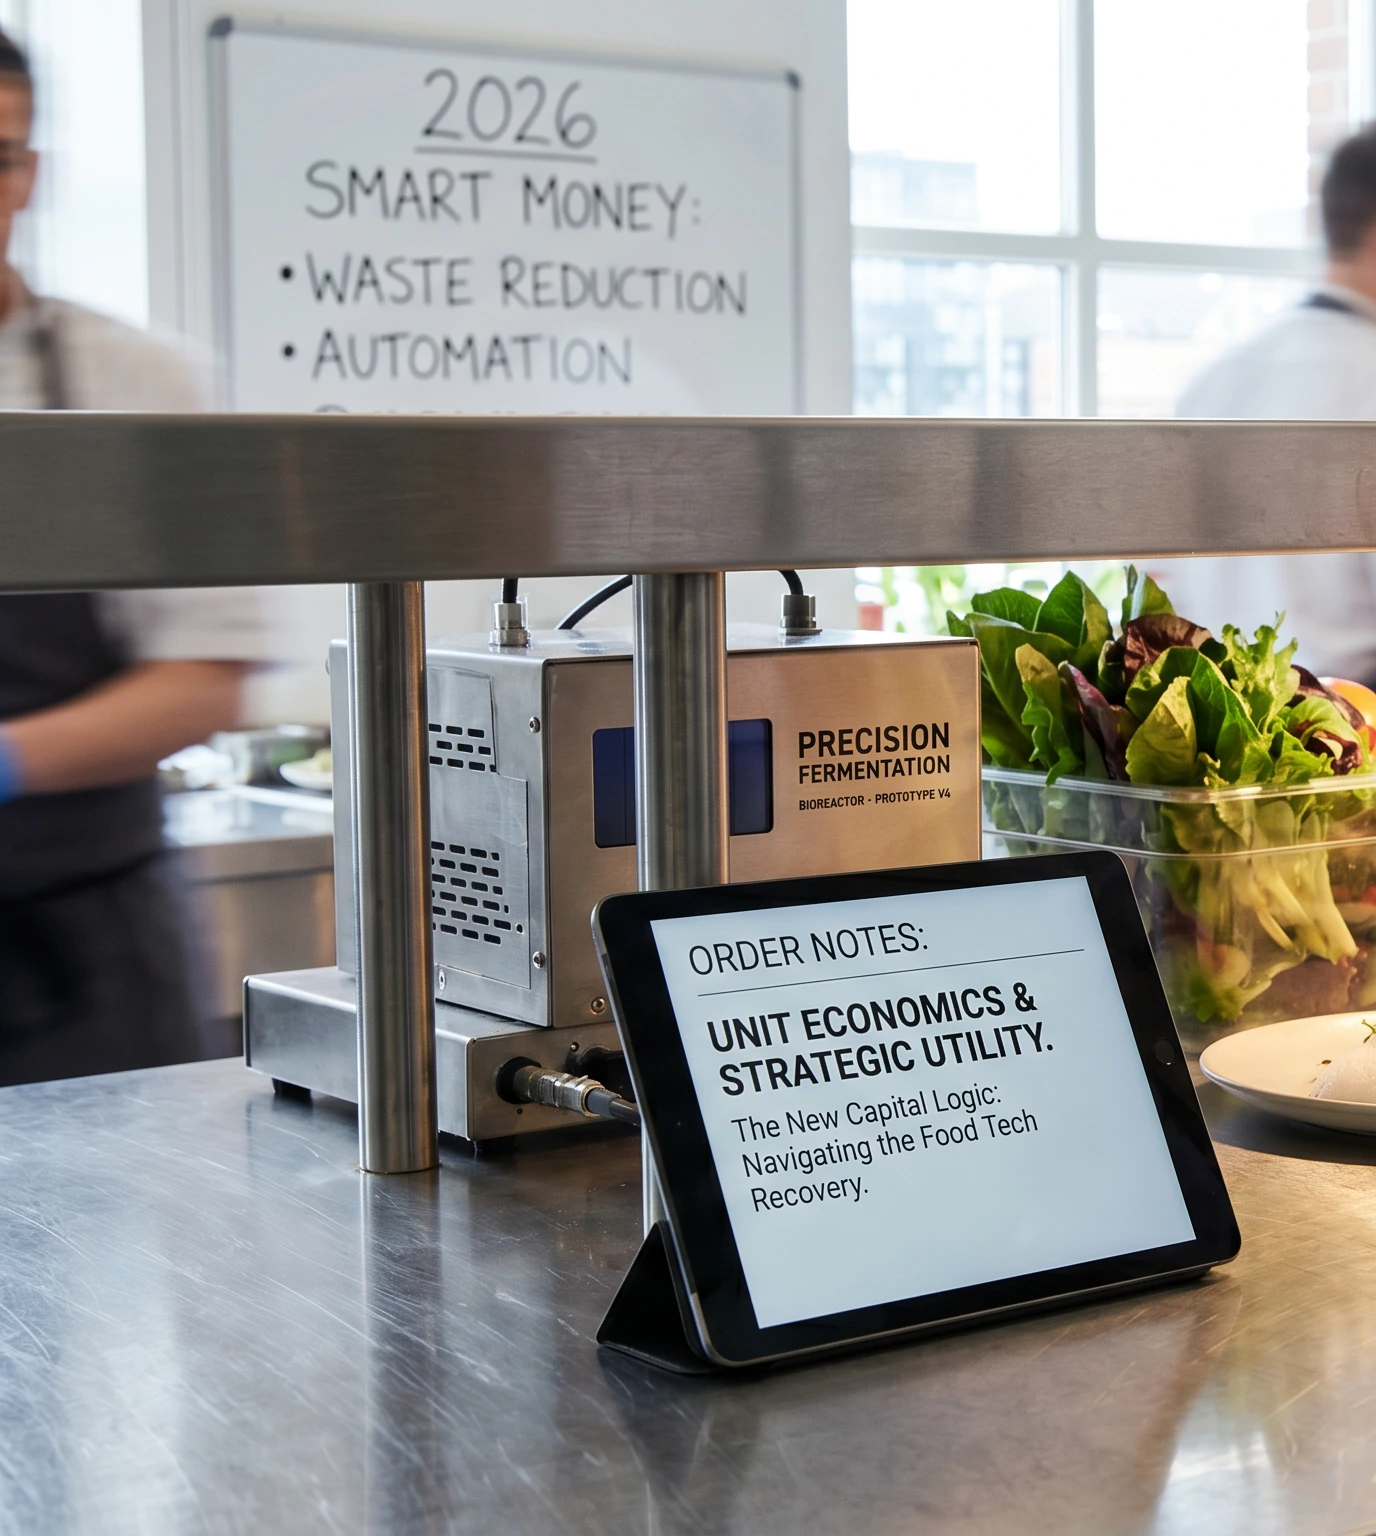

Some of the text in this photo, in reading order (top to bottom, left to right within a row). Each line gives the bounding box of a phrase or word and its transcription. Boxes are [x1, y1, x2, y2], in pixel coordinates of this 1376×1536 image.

[422, 69, 597, 148] 2026
[305, 161, 701, 239] SMART MONEY:
[306, 252, 747, 316] WASTE REDUCTION
[311, 329, 632, 385] AUTOMATION
[799, 722, 949, 758] PRECISION
[799, 755, 949, 784] FERMENTATION
[799, 794, 865, 811] BIOREACTOR
[875, 790, 935, 804] PROTOTYPE
[937, 787, 951, 799] V4
[690, 923, 927, 975] ORDER NOTES:
[707, 981, 1038, 1052] UNIT ECONOMICS &
[720, 1022, 1053, 1095] STRATEGIC UTILITY.
[731, 1083, 1000, 1142] The New Capital Logic:
[742, 1109, 1038, 1177] Navigating the Food Tech
[751, 1177, 868, 1212] Recovery.
